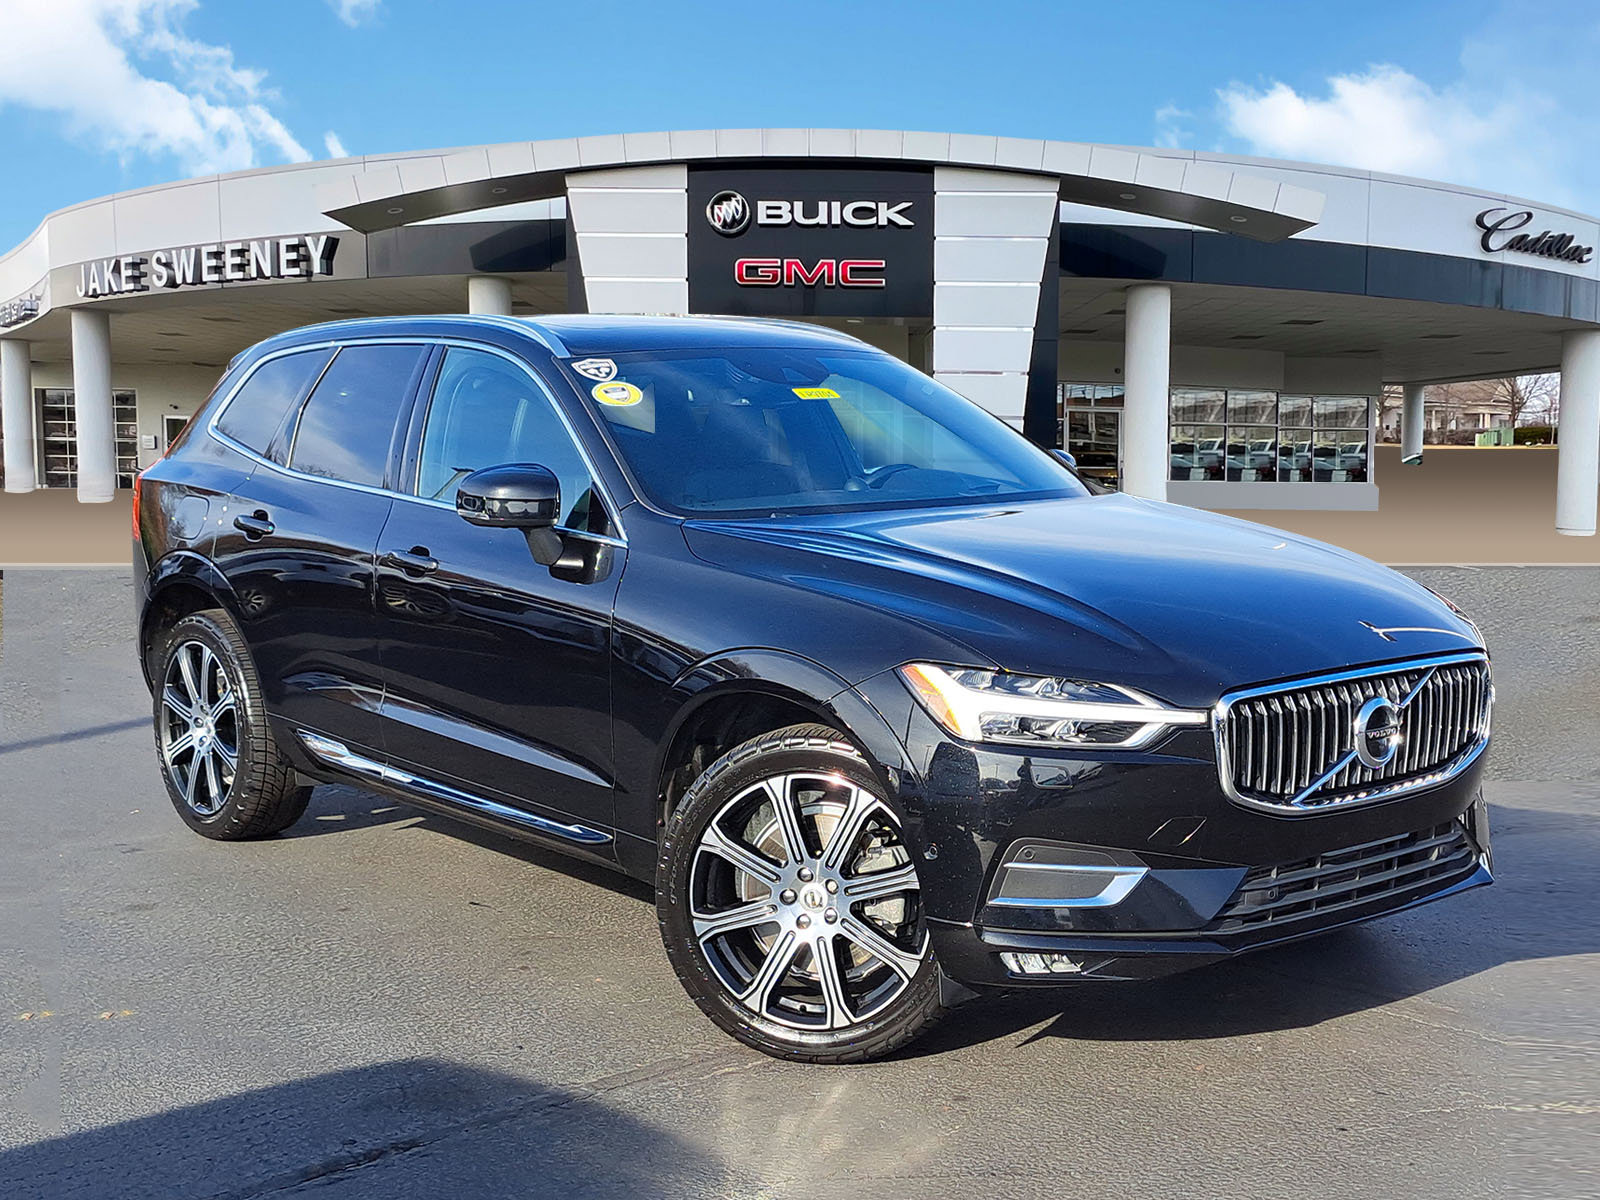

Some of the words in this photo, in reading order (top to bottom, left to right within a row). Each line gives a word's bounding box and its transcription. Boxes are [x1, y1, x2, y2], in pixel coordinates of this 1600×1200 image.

[757, 200, 915, 227] BUICK
[1475, 207, 1593, 264] Cadillac
[76, 254, 142, 298] JAKE
[152, 234, 334, 289] SWEENEY
[734, 258, 886, 287] GMC
[1366, 727, 1397, 739] VOLVO
